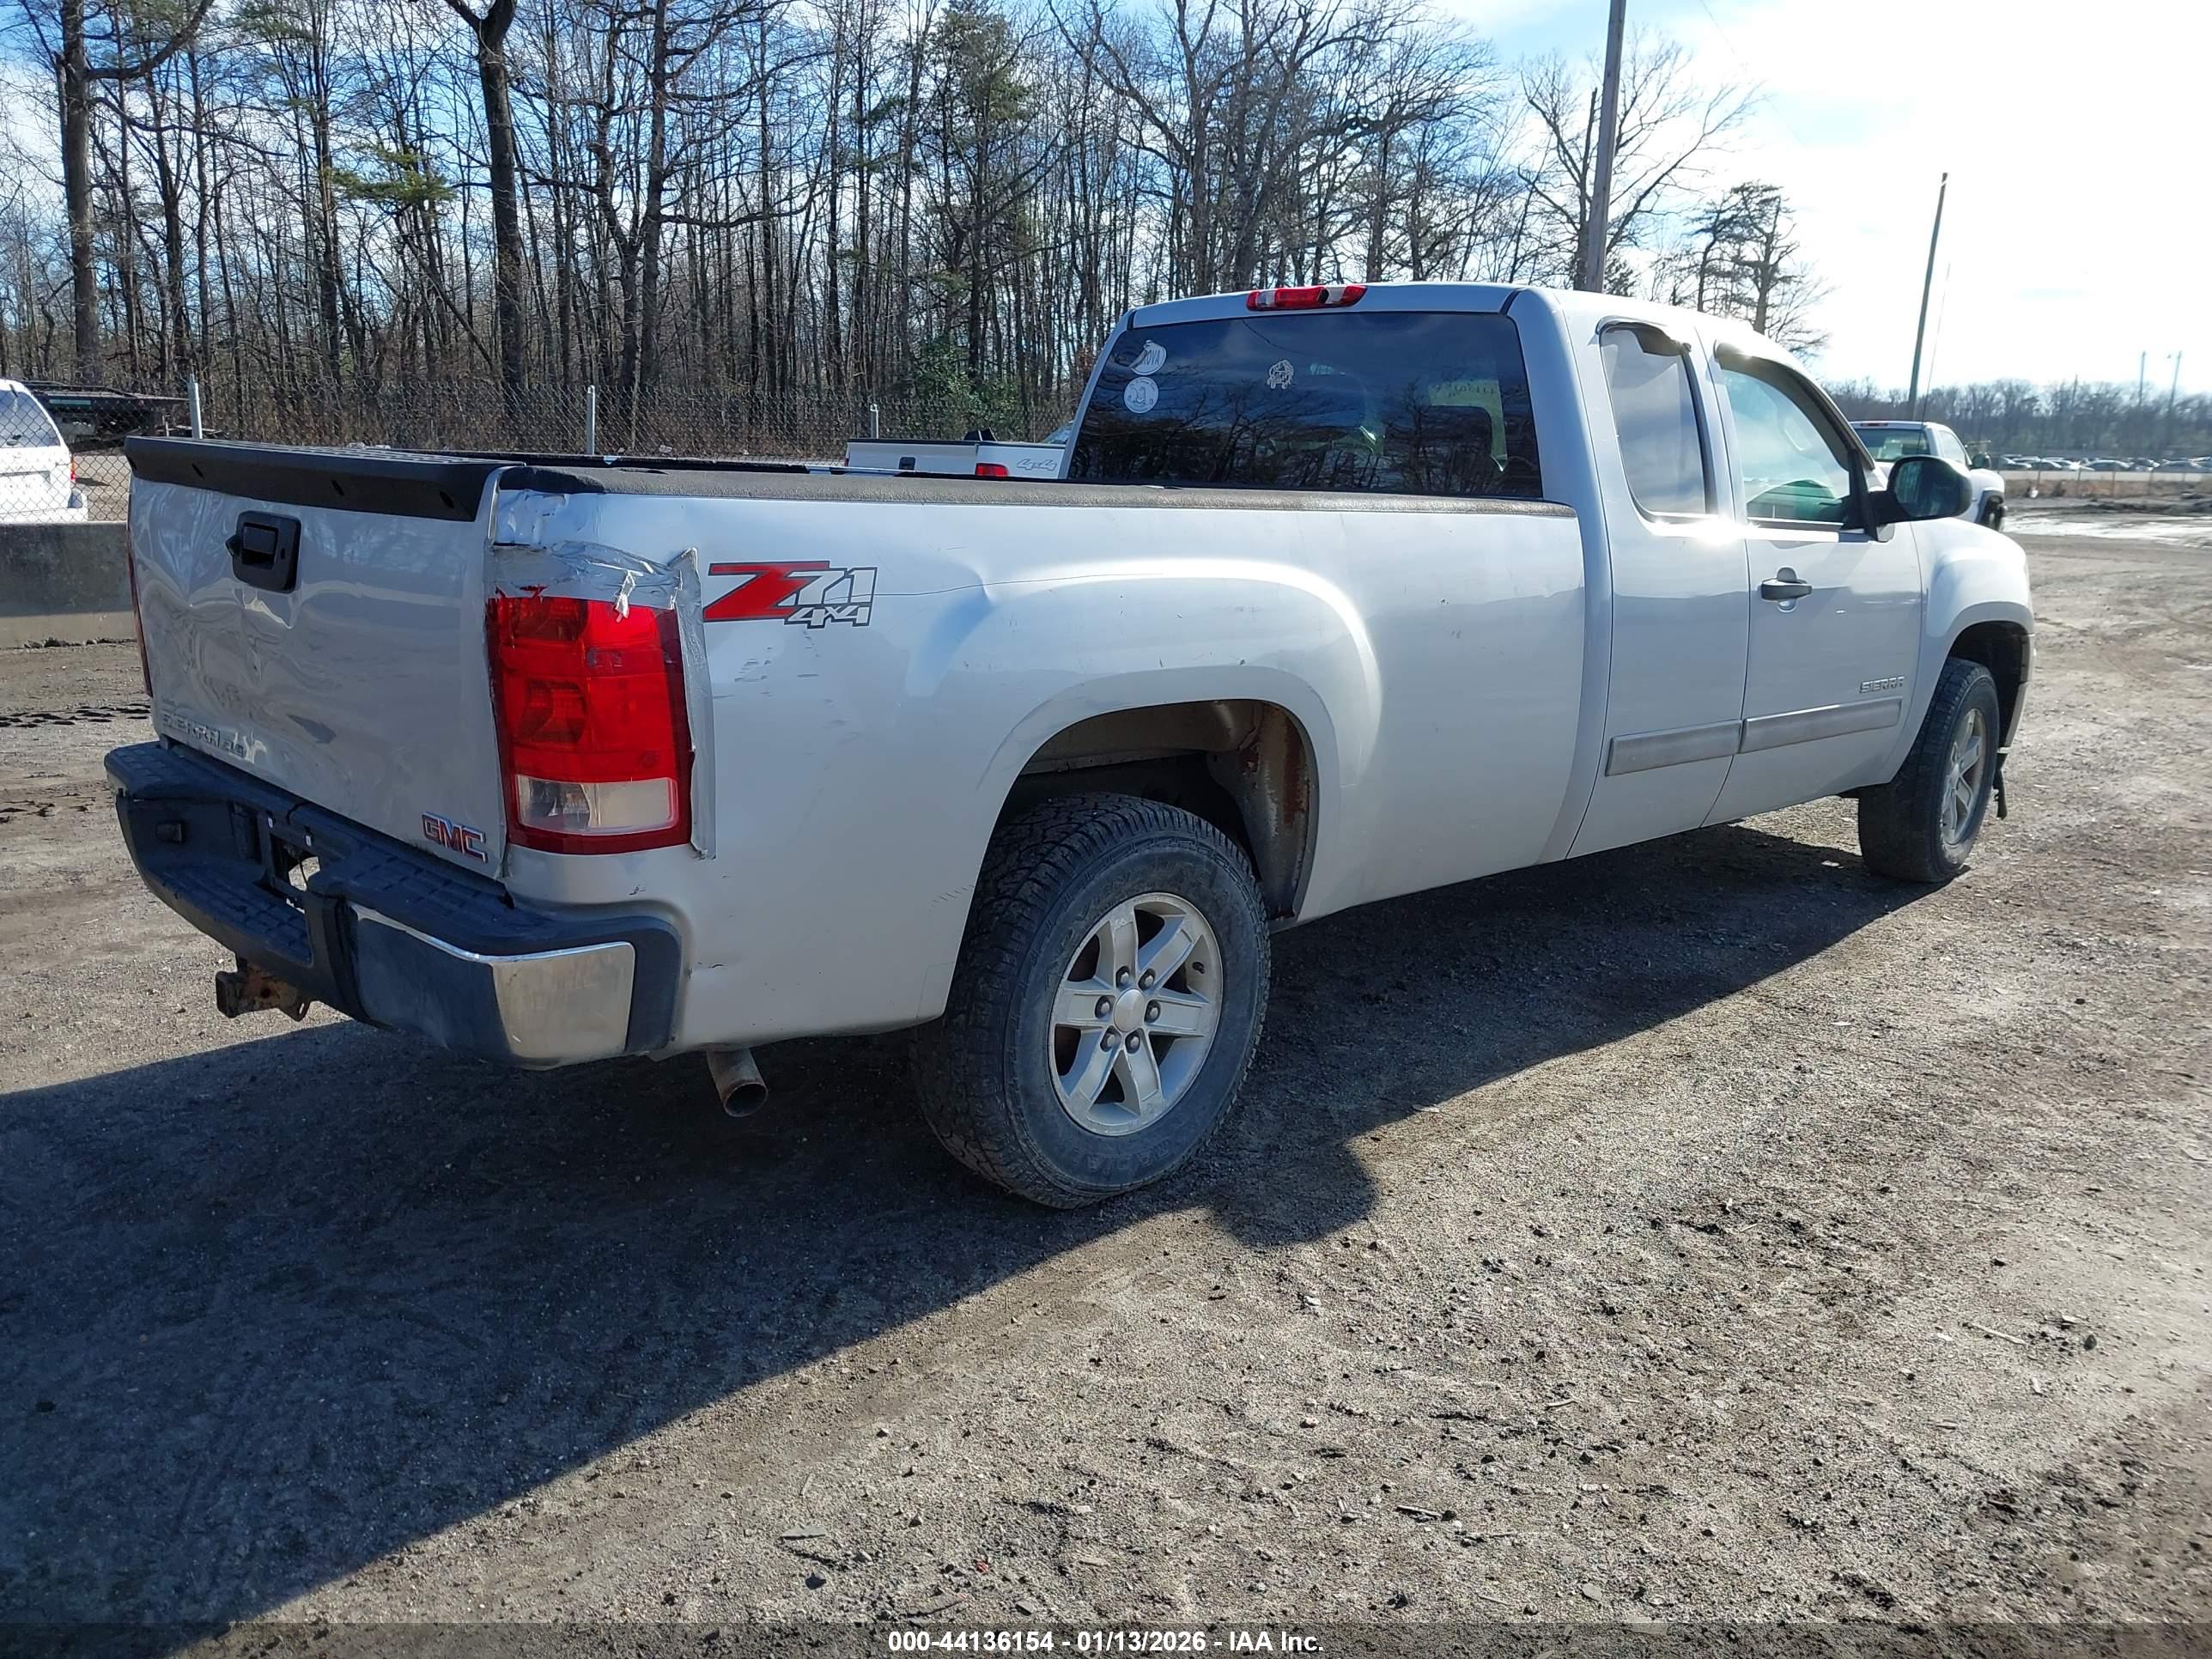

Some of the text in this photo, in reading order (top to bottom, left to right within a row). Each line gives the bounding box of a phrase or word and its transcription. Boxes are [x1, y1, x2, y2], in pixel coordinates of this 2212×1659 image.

[702, 560, 878, 623] Z71
[1859, 675, 1905, 693] SIERRA
[421, 811, 488, 864] GMC
